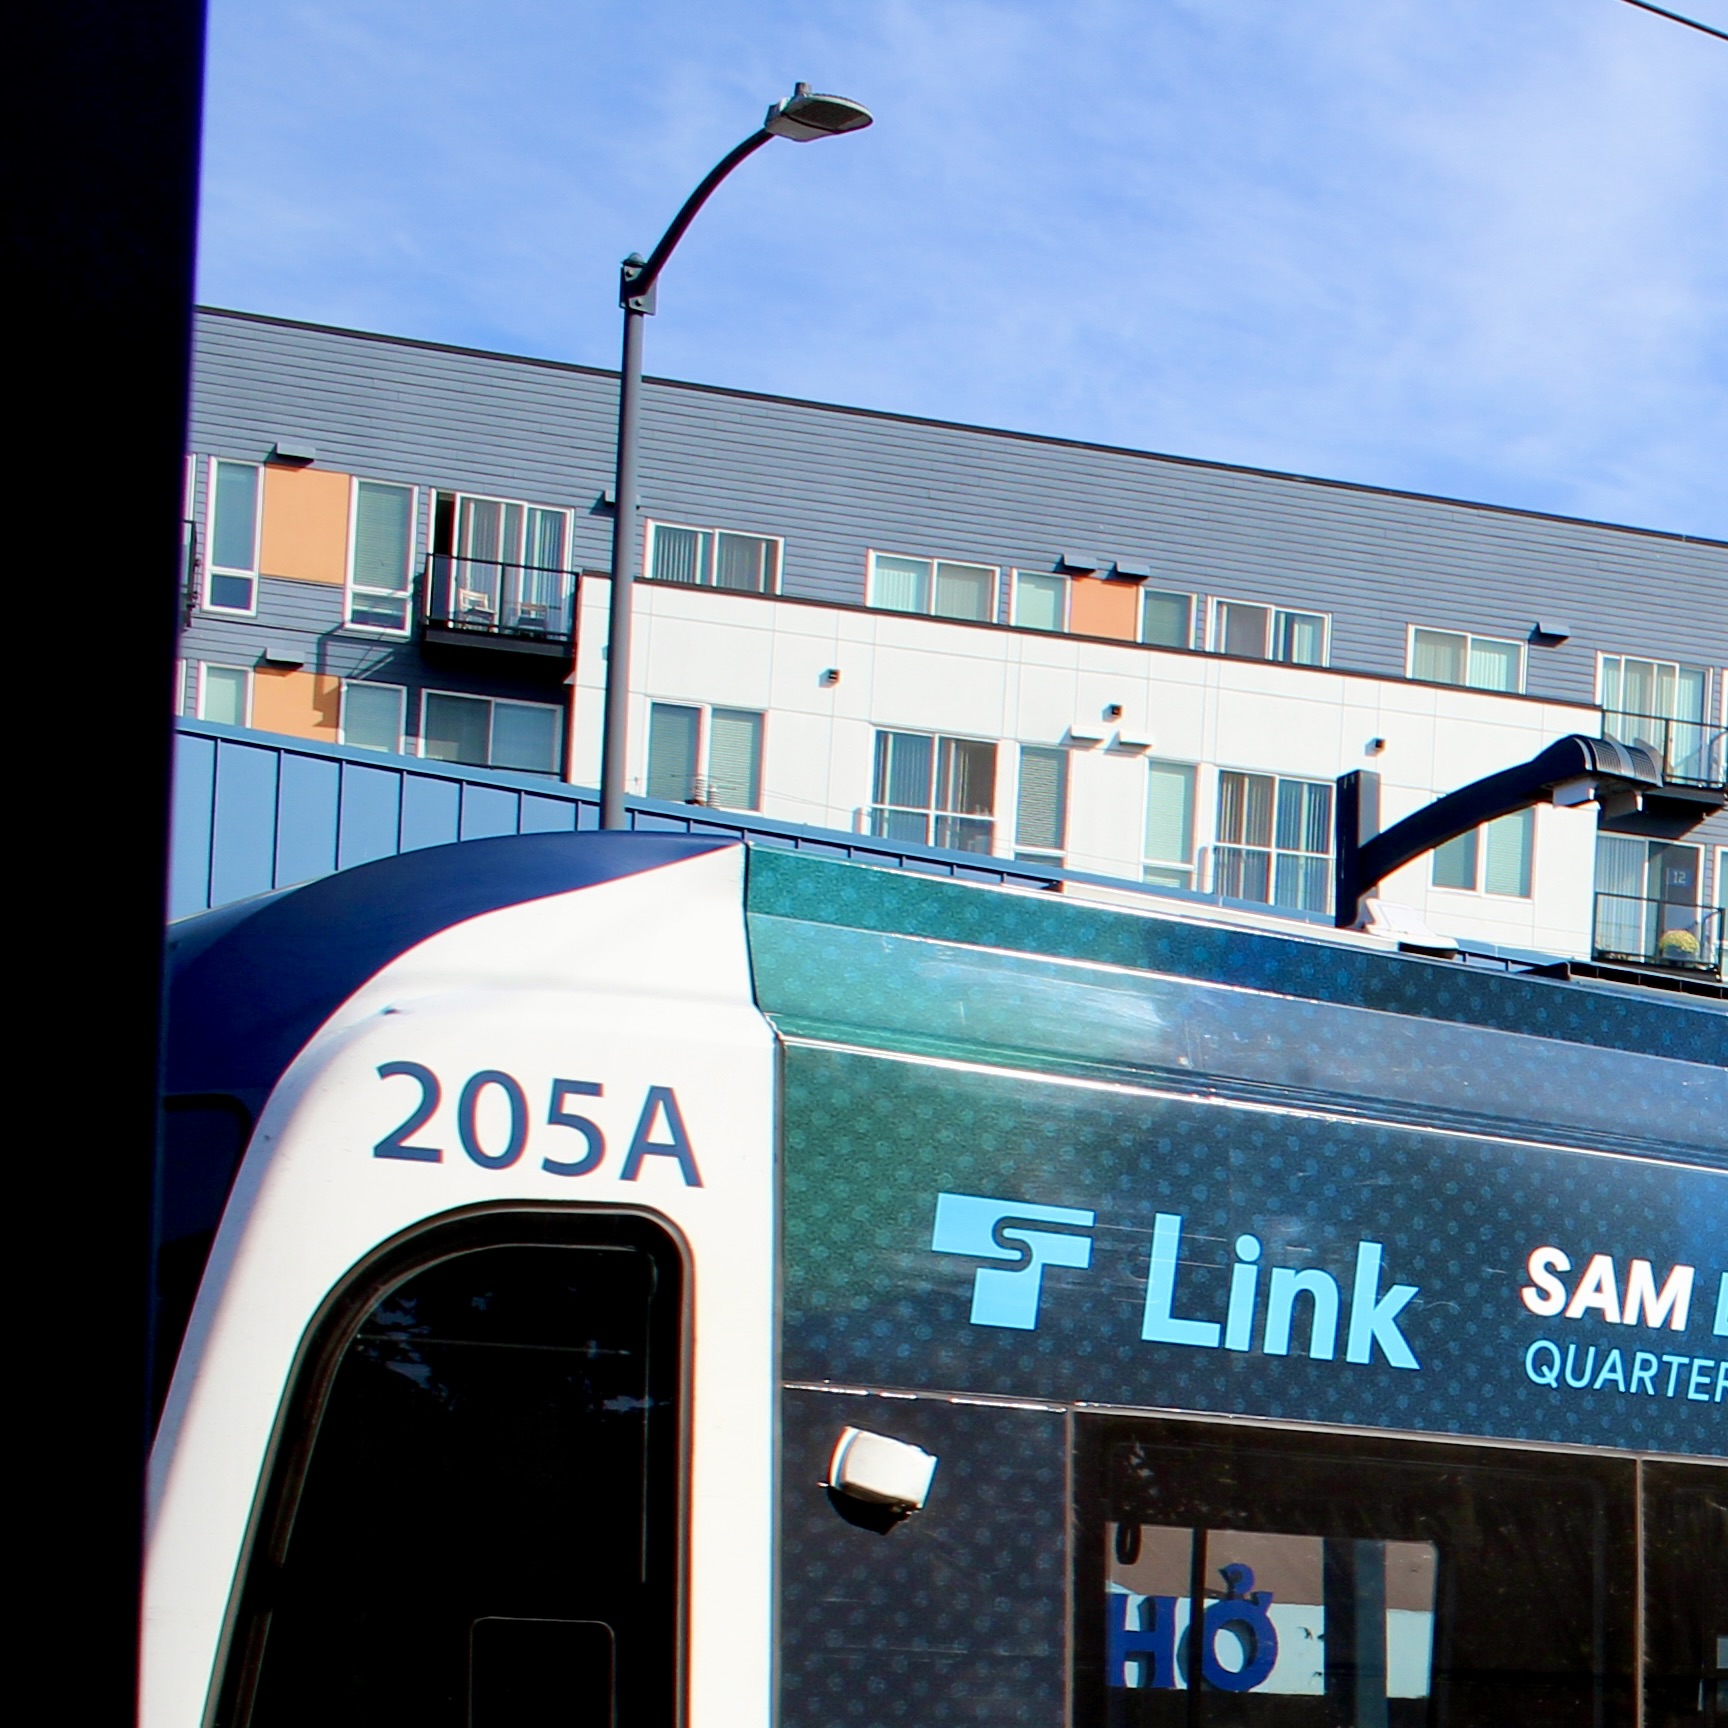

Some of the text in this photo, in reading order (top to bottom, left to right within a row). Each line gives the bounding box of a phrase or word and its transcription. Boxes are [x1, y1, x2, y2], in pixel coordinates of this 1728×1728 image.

[372, 1060, 704, 1188] 205A
[1141, 1212, 1420, 1370] Link
[1521, 1246, 1694, 1332] SAM
